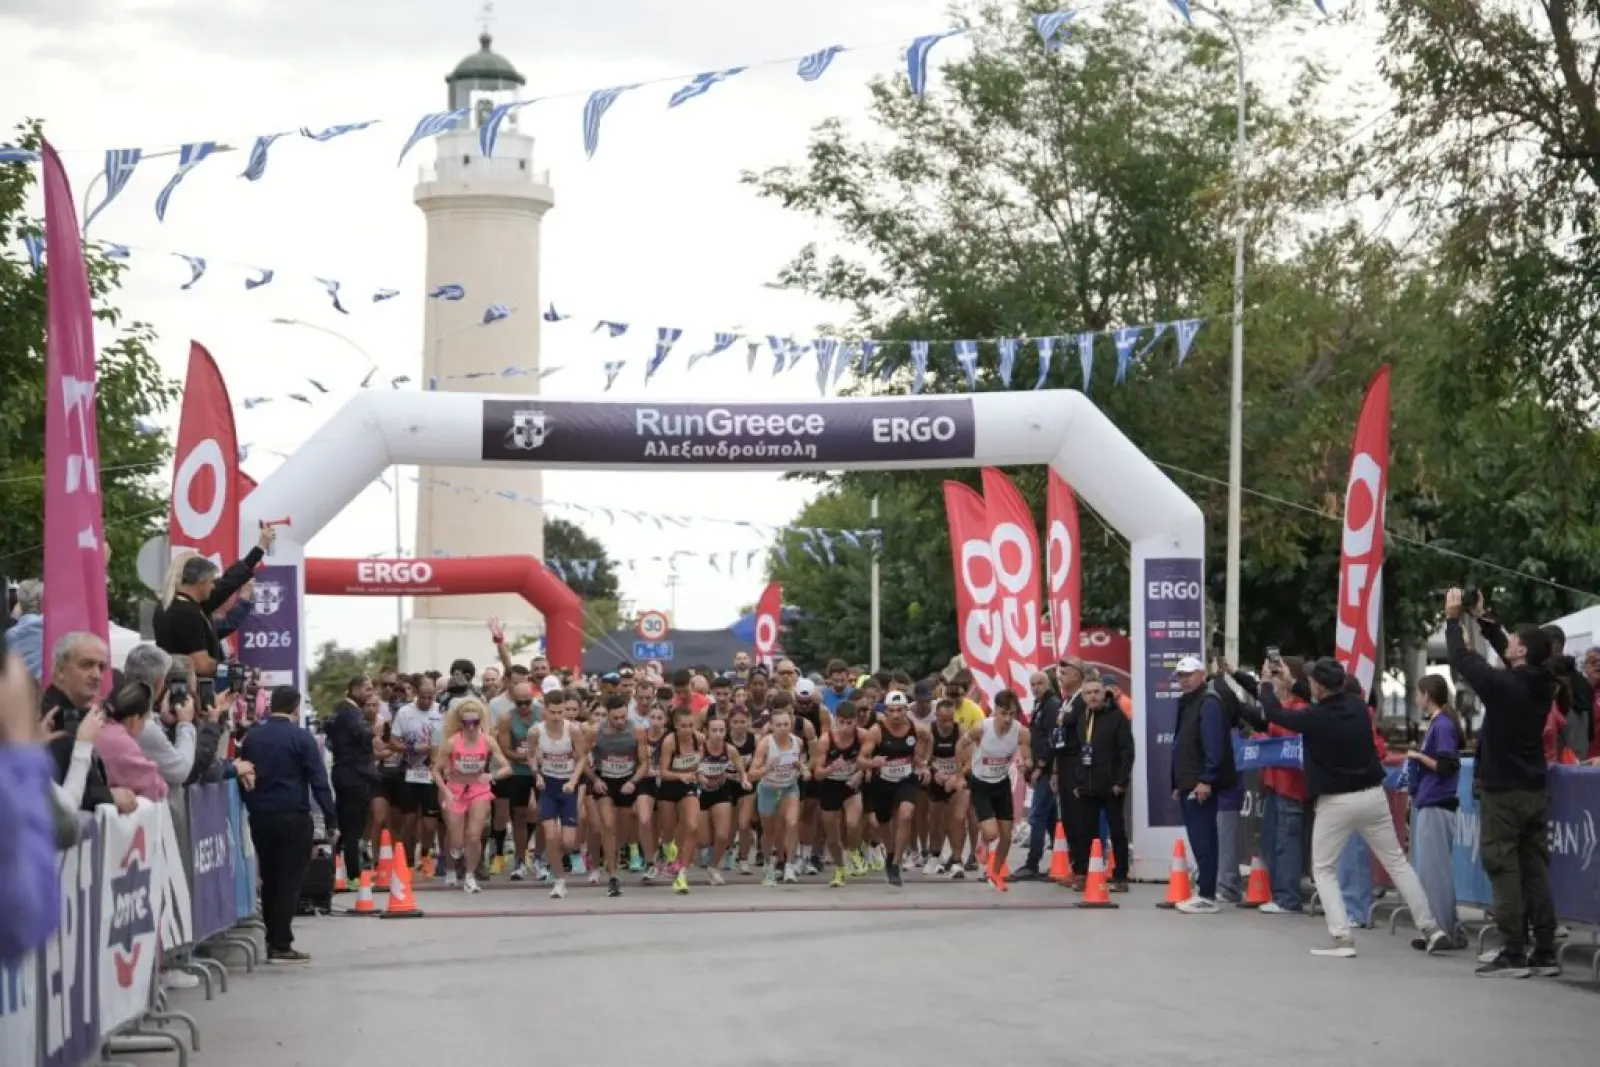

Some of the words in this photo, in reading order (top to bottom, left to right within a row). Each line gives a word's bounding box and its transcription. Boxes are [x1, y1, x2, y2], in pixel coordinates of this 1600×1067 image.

[635, 408, 825, 436] RunGreece
[872, 415, 956, 443] ERGO
[644, 440, 817, 460] Αλεξανδρούπολη
[357, 561, 433, 584] ERGO
[1148, 580, 1200, 600] ERGO
[643, 618, 663, 632] 30
[244, 630, 292, 649] 2026
[1041, 630, 1112, 648] EGO
